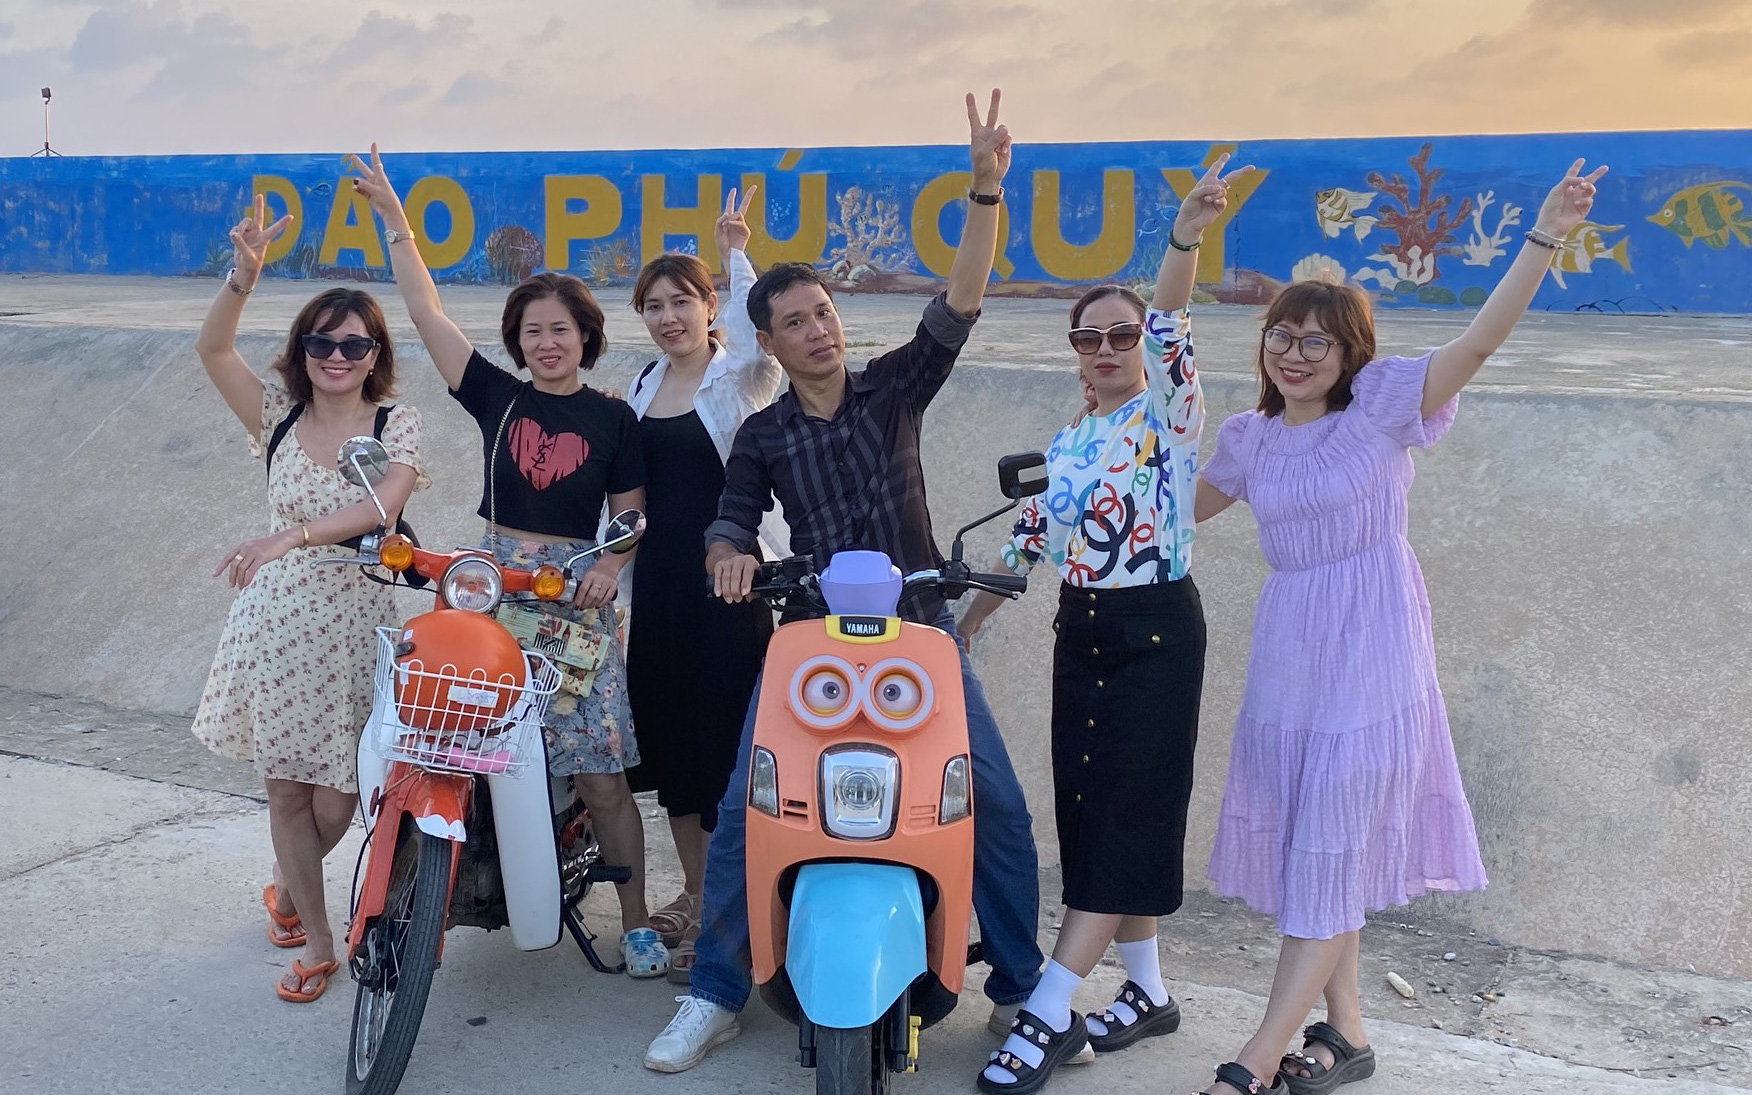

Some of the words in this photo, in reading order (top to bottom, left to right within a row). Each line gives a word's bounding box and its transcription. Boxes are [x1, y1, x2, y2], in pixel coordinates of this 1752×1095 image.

[544, 150, 827, 275] PHÚ
[911, 144, 1270, 284] QUÝ
[846, 623, 880, 634] YAMAHA
